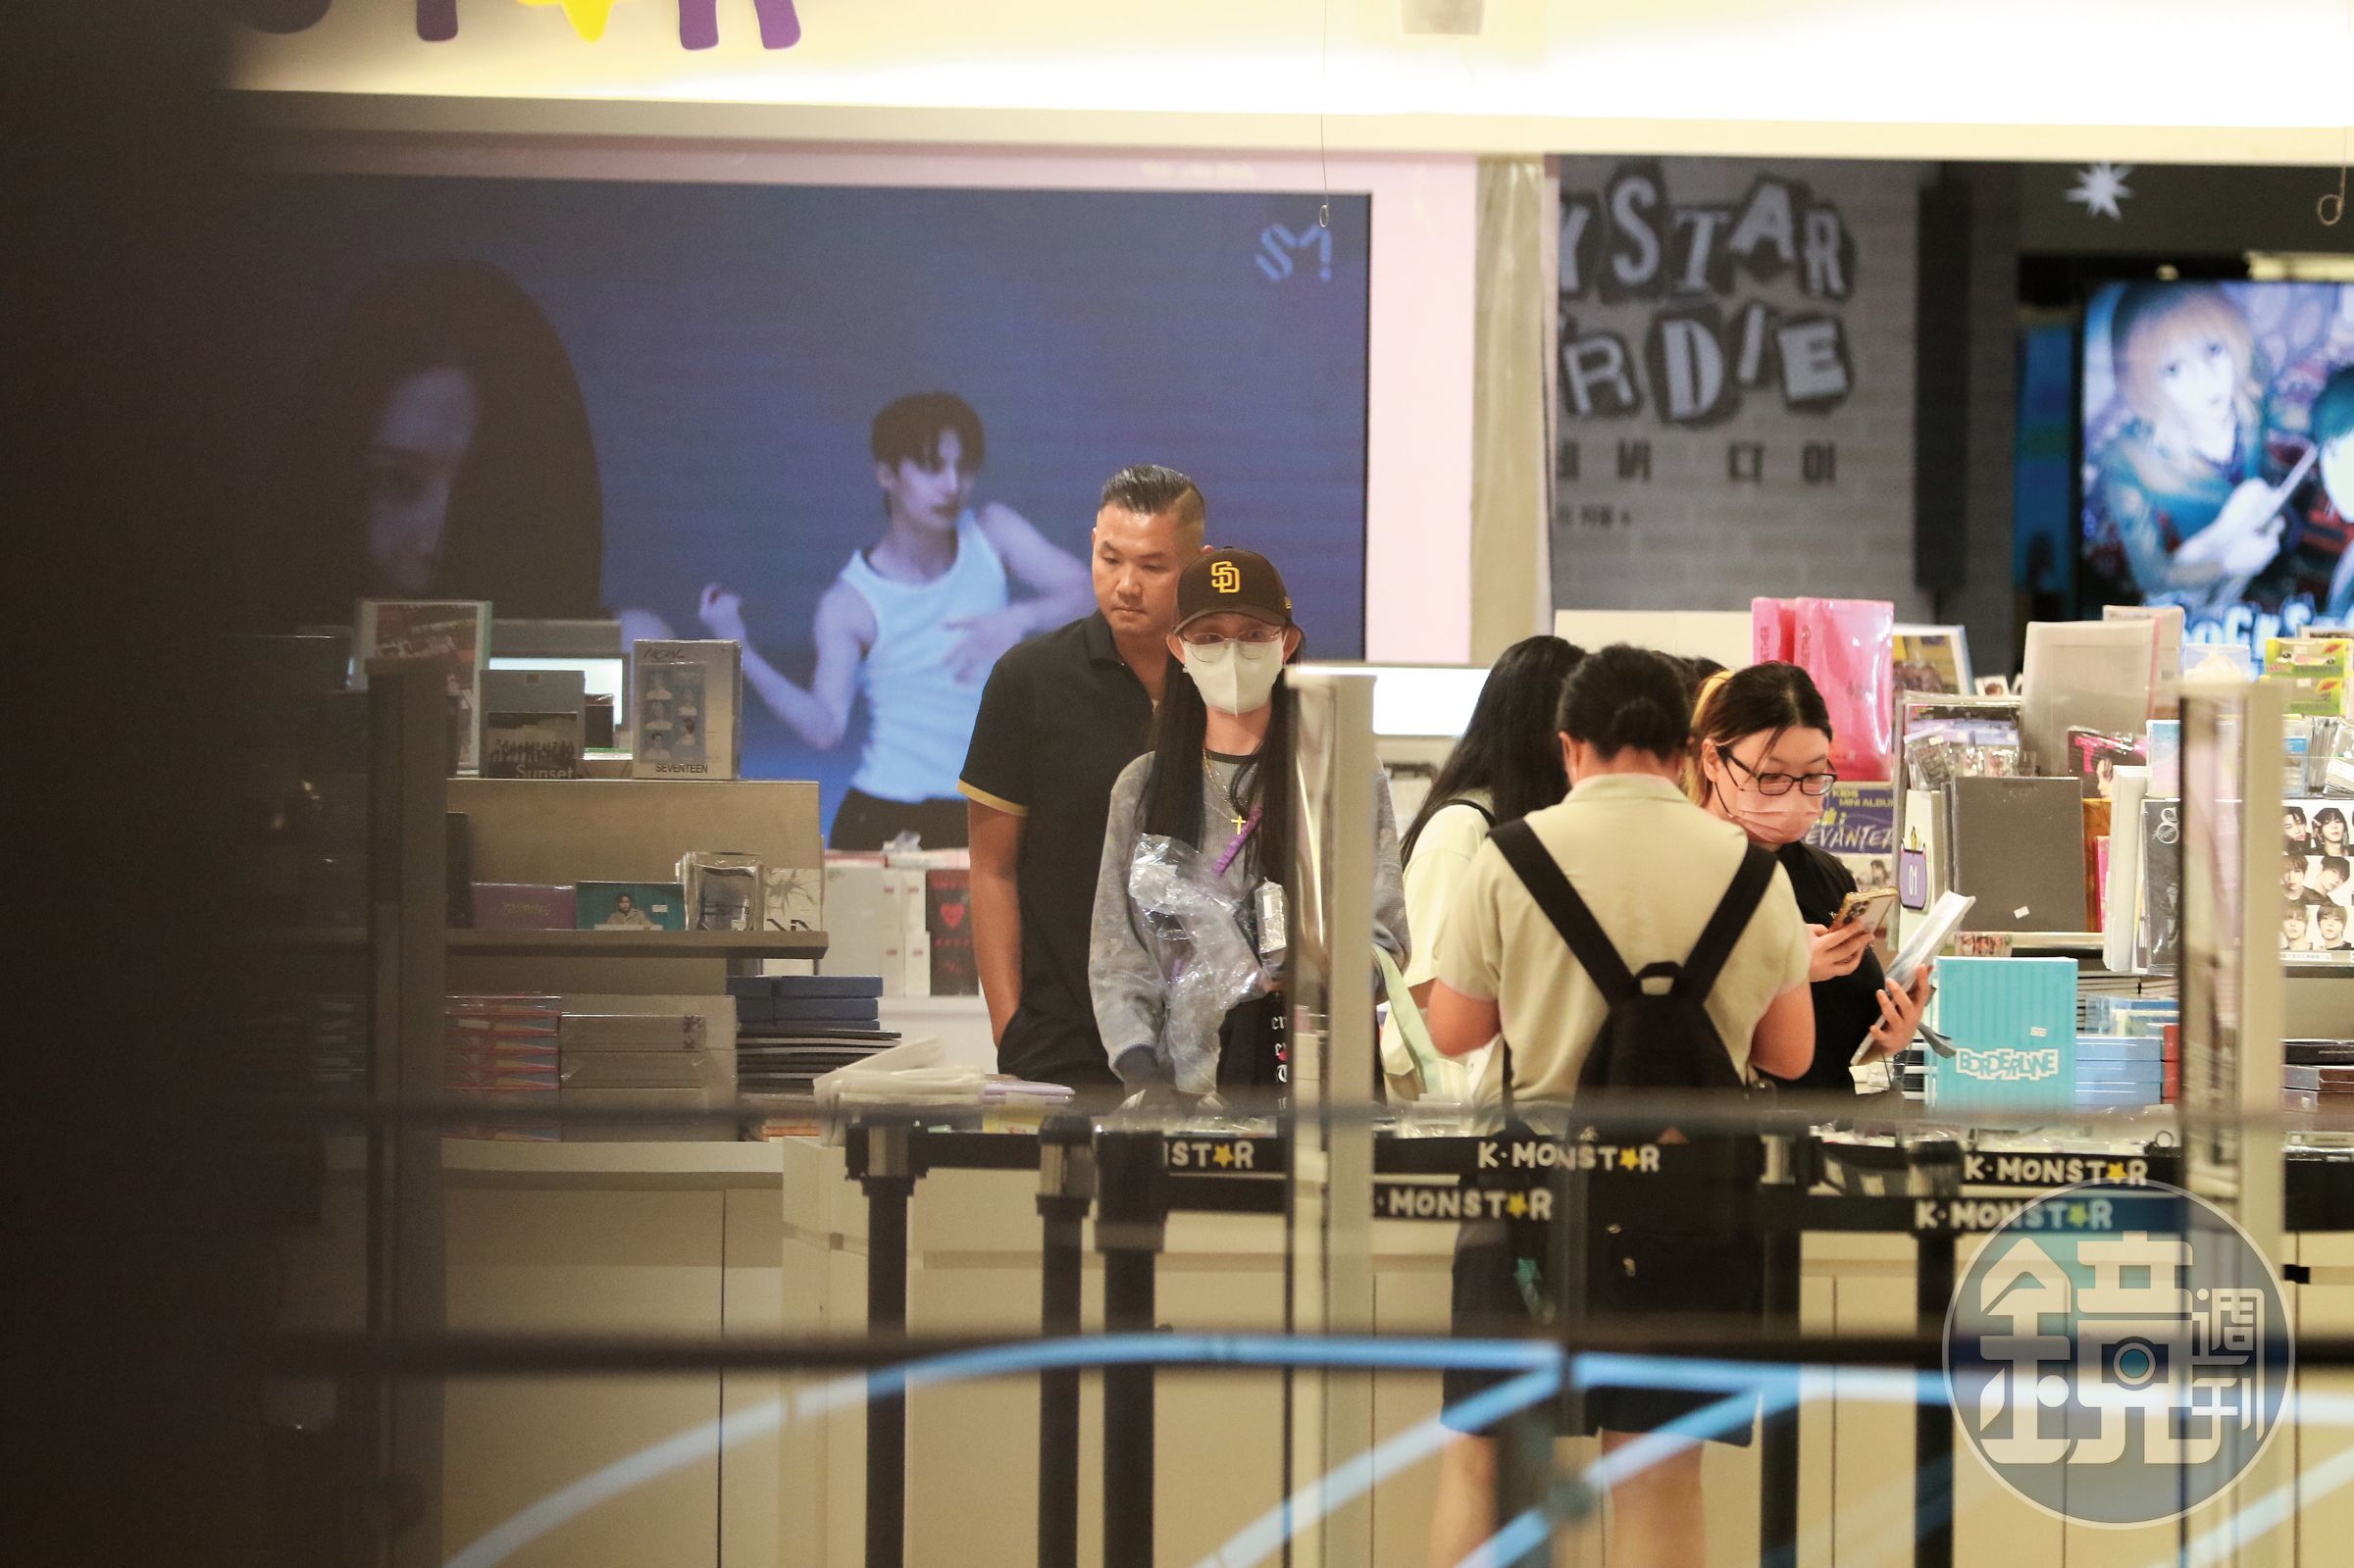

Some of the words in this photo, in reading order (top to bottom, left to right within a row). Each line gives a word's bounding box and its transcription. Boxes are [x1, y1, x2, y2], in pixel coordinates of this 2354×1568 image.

[1211, 561, 1240, 593] SD
[516, 765, 574, 779] Sunset
[655, 763, 708, 774] SEVENTEEN
[1956, 1047, 2058, 1081] BORDERLINE
